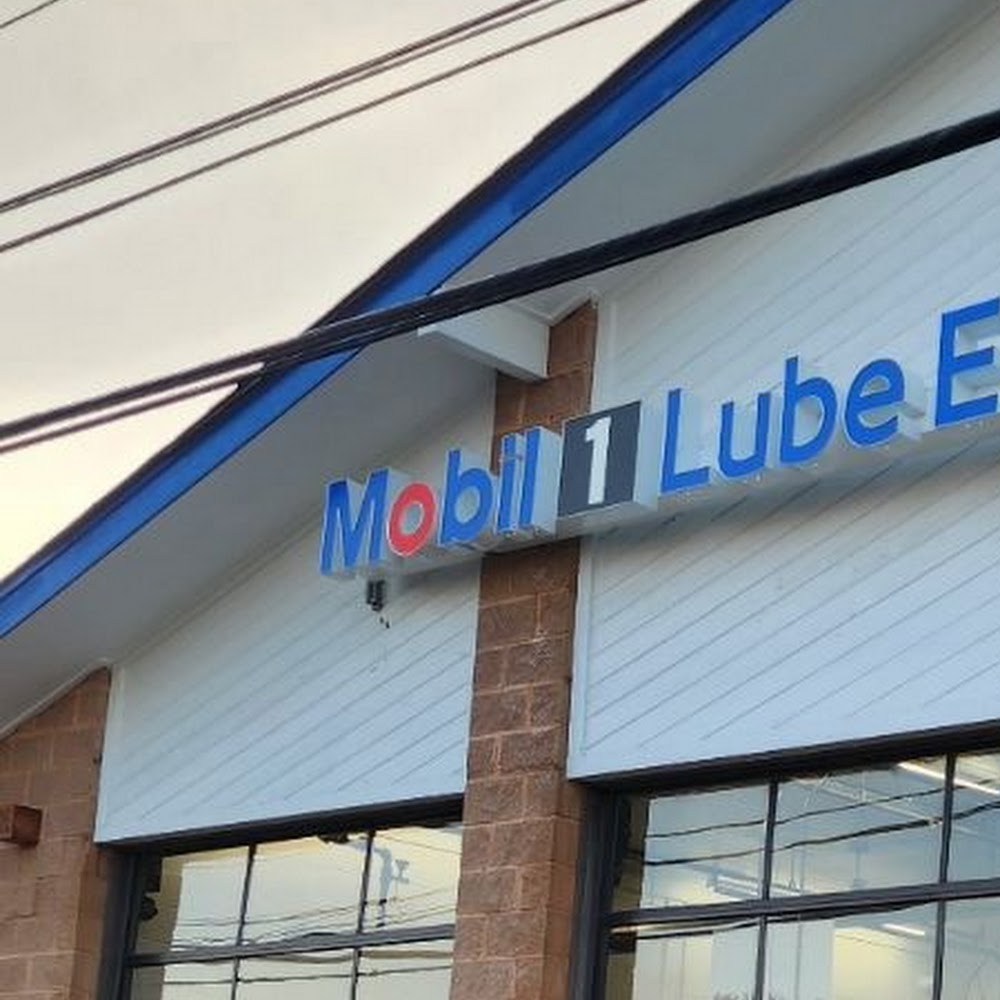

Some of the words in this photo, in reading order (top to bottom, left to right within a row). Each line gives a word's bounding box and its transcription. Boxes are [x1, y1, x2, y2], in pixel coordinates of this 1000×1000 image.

[320, 428, 540, 575] Mobil
[583, 416, 613, 506] 1
[660, 356, 904, 493] Lube
